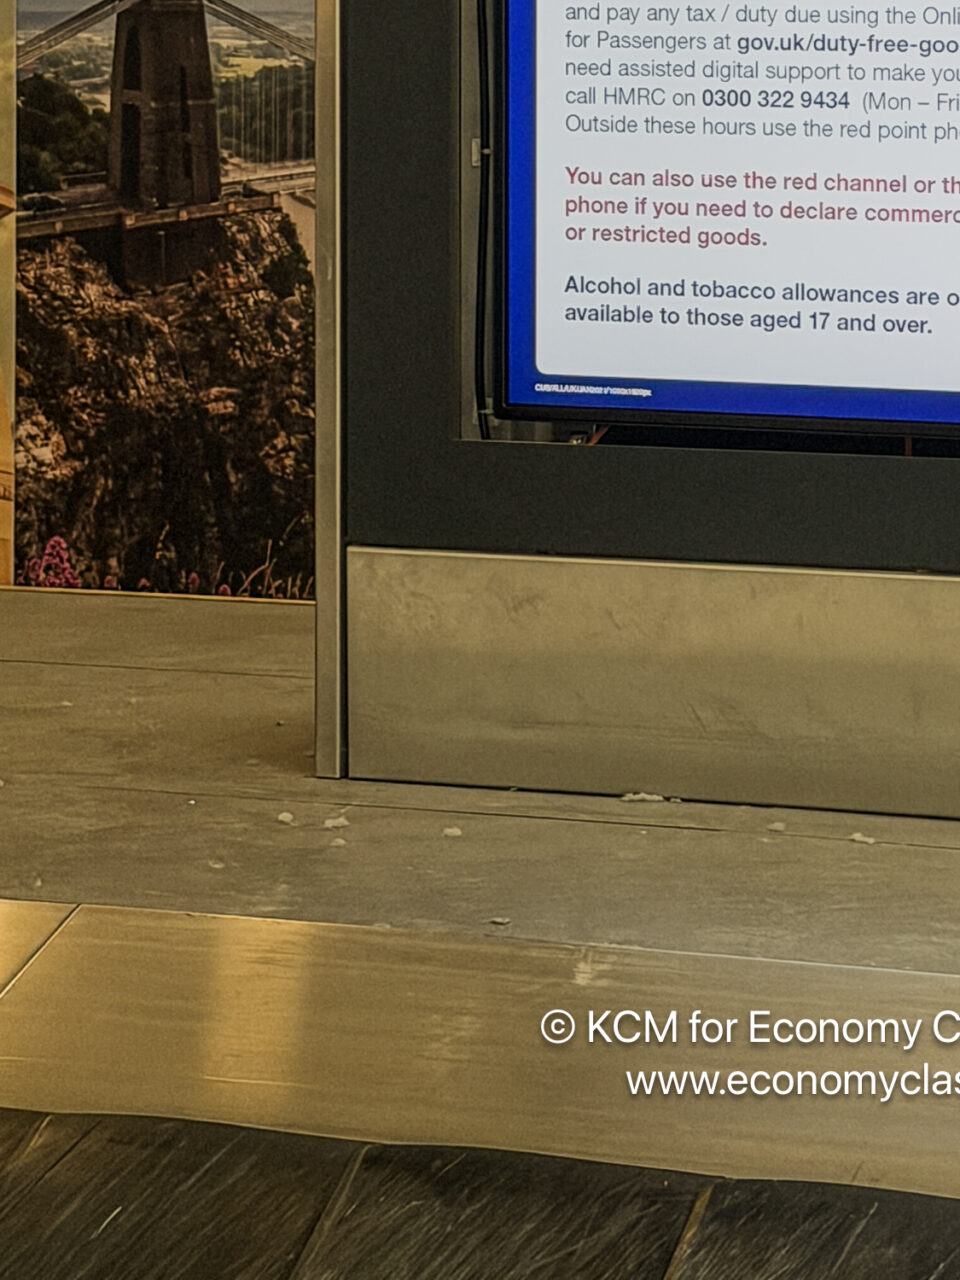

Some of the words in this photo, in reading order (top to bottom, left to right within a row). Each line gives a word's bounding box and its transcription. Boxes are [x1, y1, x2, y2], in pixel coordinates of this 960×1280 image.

[565, 30, 591, 49] for
[597, 30, 707, 54] Passengers
[713, 33, 731, 51] at
[565, 86, 596, 105] call
[604, 86, 665, 106] HMRC
[672, 92, 695, 107] on
[702, 88, 751, 108] 0300
[757, 89, 794, 109] 322
[800, 90, 850, 110] 9434
[863, 91, 911, 114] (Mon
[937, 92, 960, 112] Fri
[566, 195, 628, 218] phone
[635, 196, 647, 216] if
[652, 201, 689, 220] you
[696, 199, 746, 218] need
[753, 201, 773, 219] to
[780, 200, 858, 221] declare
[565, 227, 586, 241] or
[592, 224, 690, 244] restricted
[698, 227, 767, 250] goods.
[564, 275, 641, 296] Alcohol
[647, 278, 685, 298] and
[691, 279, 776, 301] tobacco
[782, 282, 899, 305] allowances
[906, 290, 940, 306] are
[565, 303, 653, 324] available
[659, 307, 680, 325] to
[686, 307, 744, 327] those
[750, 310, 801, 333] aged
[809, 311, 830, 331] 17
[837, 312, 876, 333] and
[883, 318, 932, 334] over.
